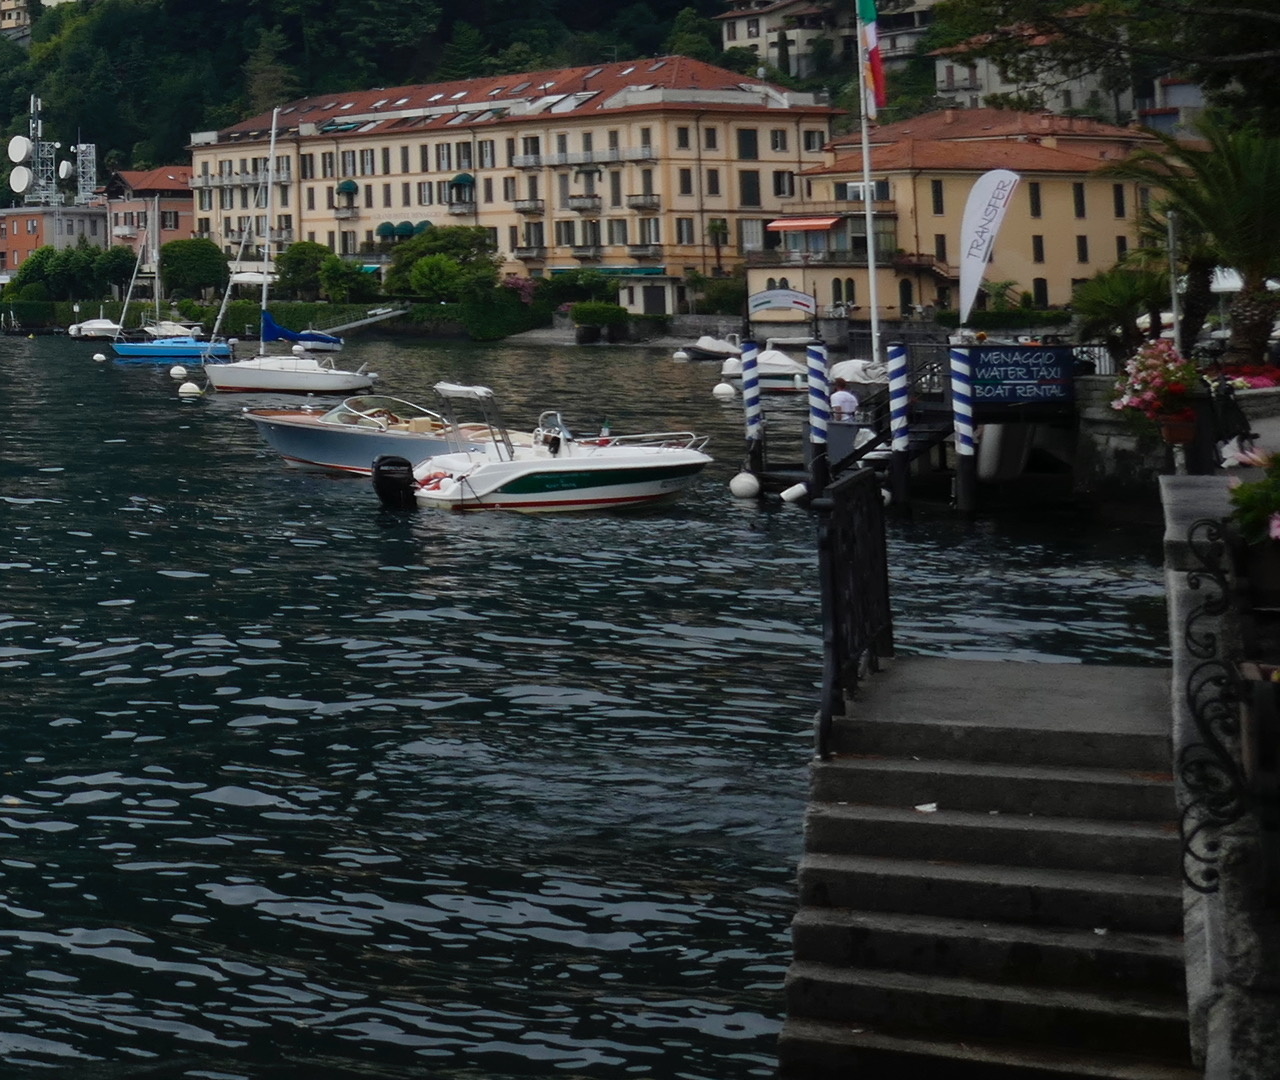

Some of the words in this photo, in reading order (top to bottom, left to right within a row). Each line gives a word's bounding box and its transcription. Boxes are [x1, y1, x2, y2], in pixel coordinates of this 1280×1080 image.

[966, 180, 1012, 259] TRANSFER
[980, 352, 1056, 366] MENAGGIO
[975, 367, 1028, 379] WATER
[1030, 367, 1062, 379] TAXI
[974, 385, 1013, 397] BOAT
[1016, 385, 1066, 397] RENTAL
